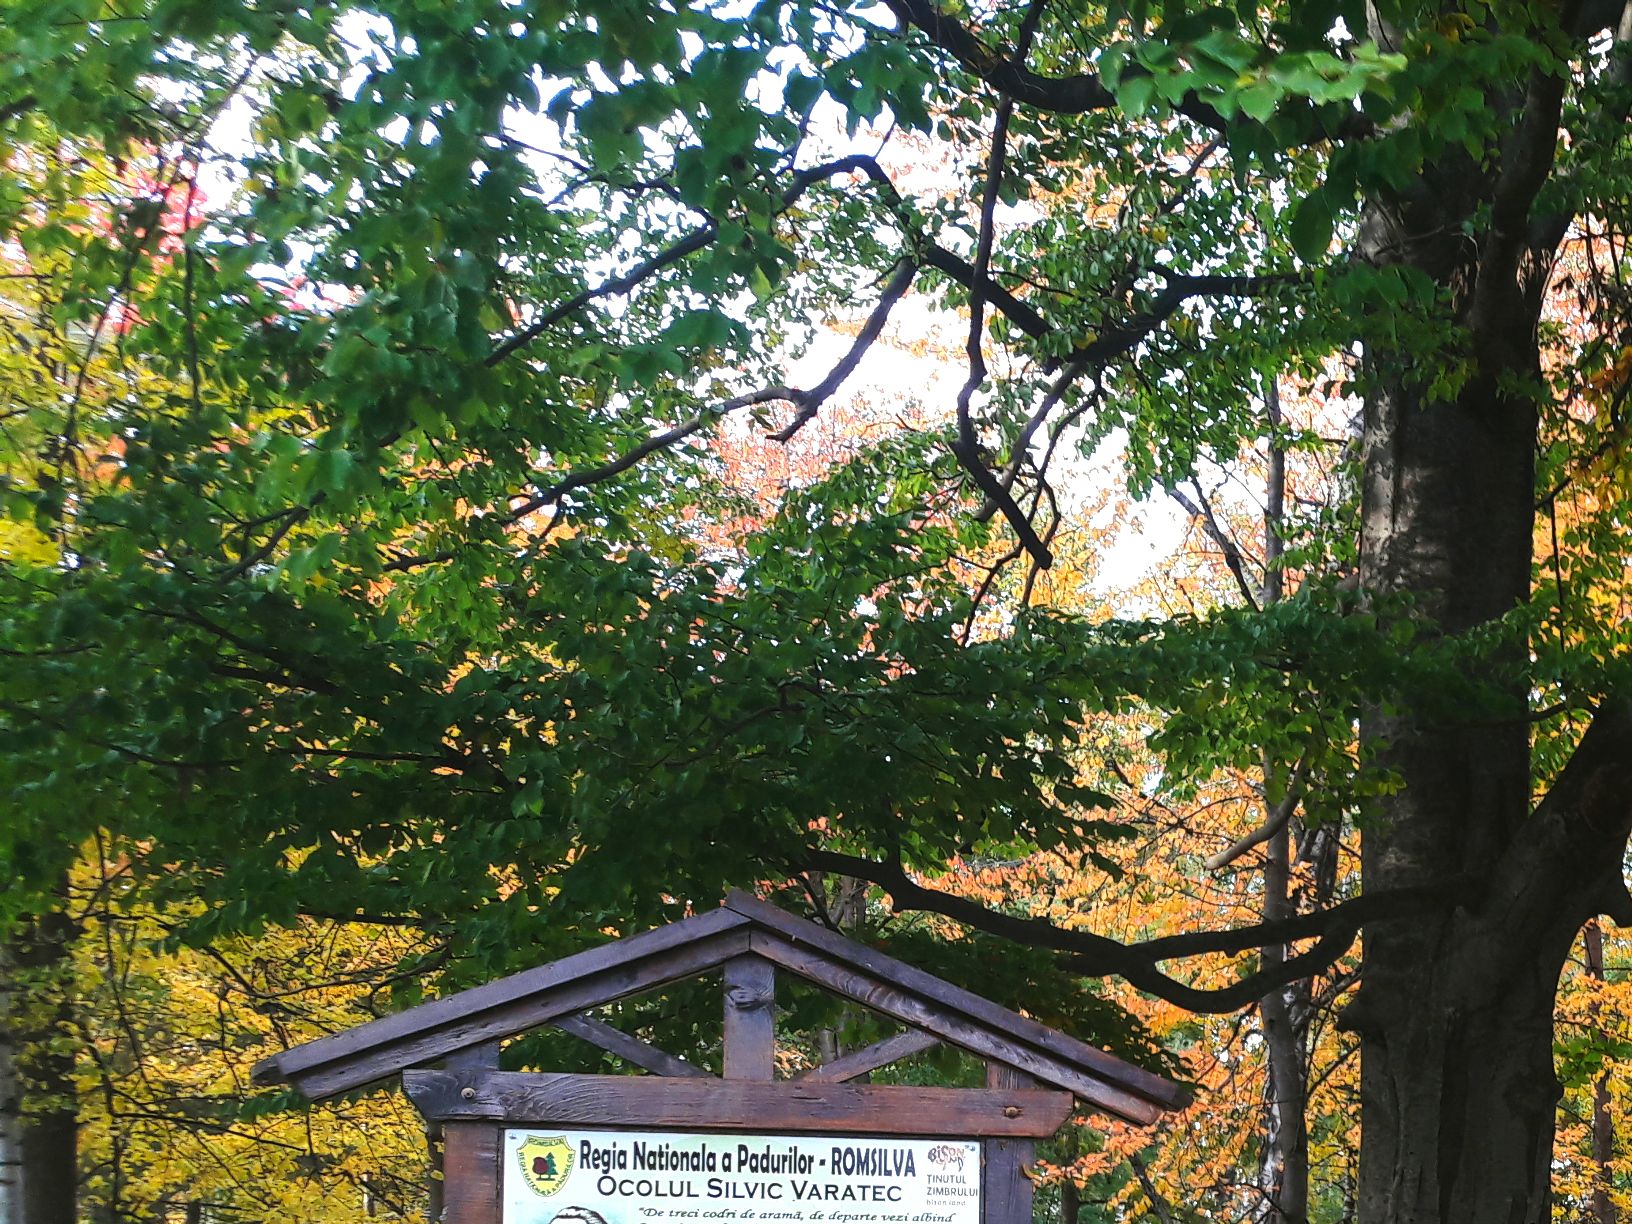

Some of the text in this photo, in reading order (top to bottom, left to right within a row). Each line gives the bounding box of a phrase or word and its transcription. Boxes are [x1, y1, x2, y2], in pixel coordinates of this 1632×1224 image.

[579, 1139, 628, 1174] Regia
[633, 1141, 716, 1173] Nationala
[721, 1155, 732, 1173] a
[737, 1144, 814, 1175] Padurilor
[831, 1147, 916, 1177] ROMSILVA
[926, 1187, 978, 1197] ZIMBRULUI
[669, 1209, 699, 1217] treci
[703, 1209, 737, 1218] codri
[740, 1209, 755, 1218] de
[809, 1210, 824, 1220] de
[828, 1211, 877, 1223] departe
[881, 1213, 909, 1221] vezi
[912, 1213, 956, 1222] albind
